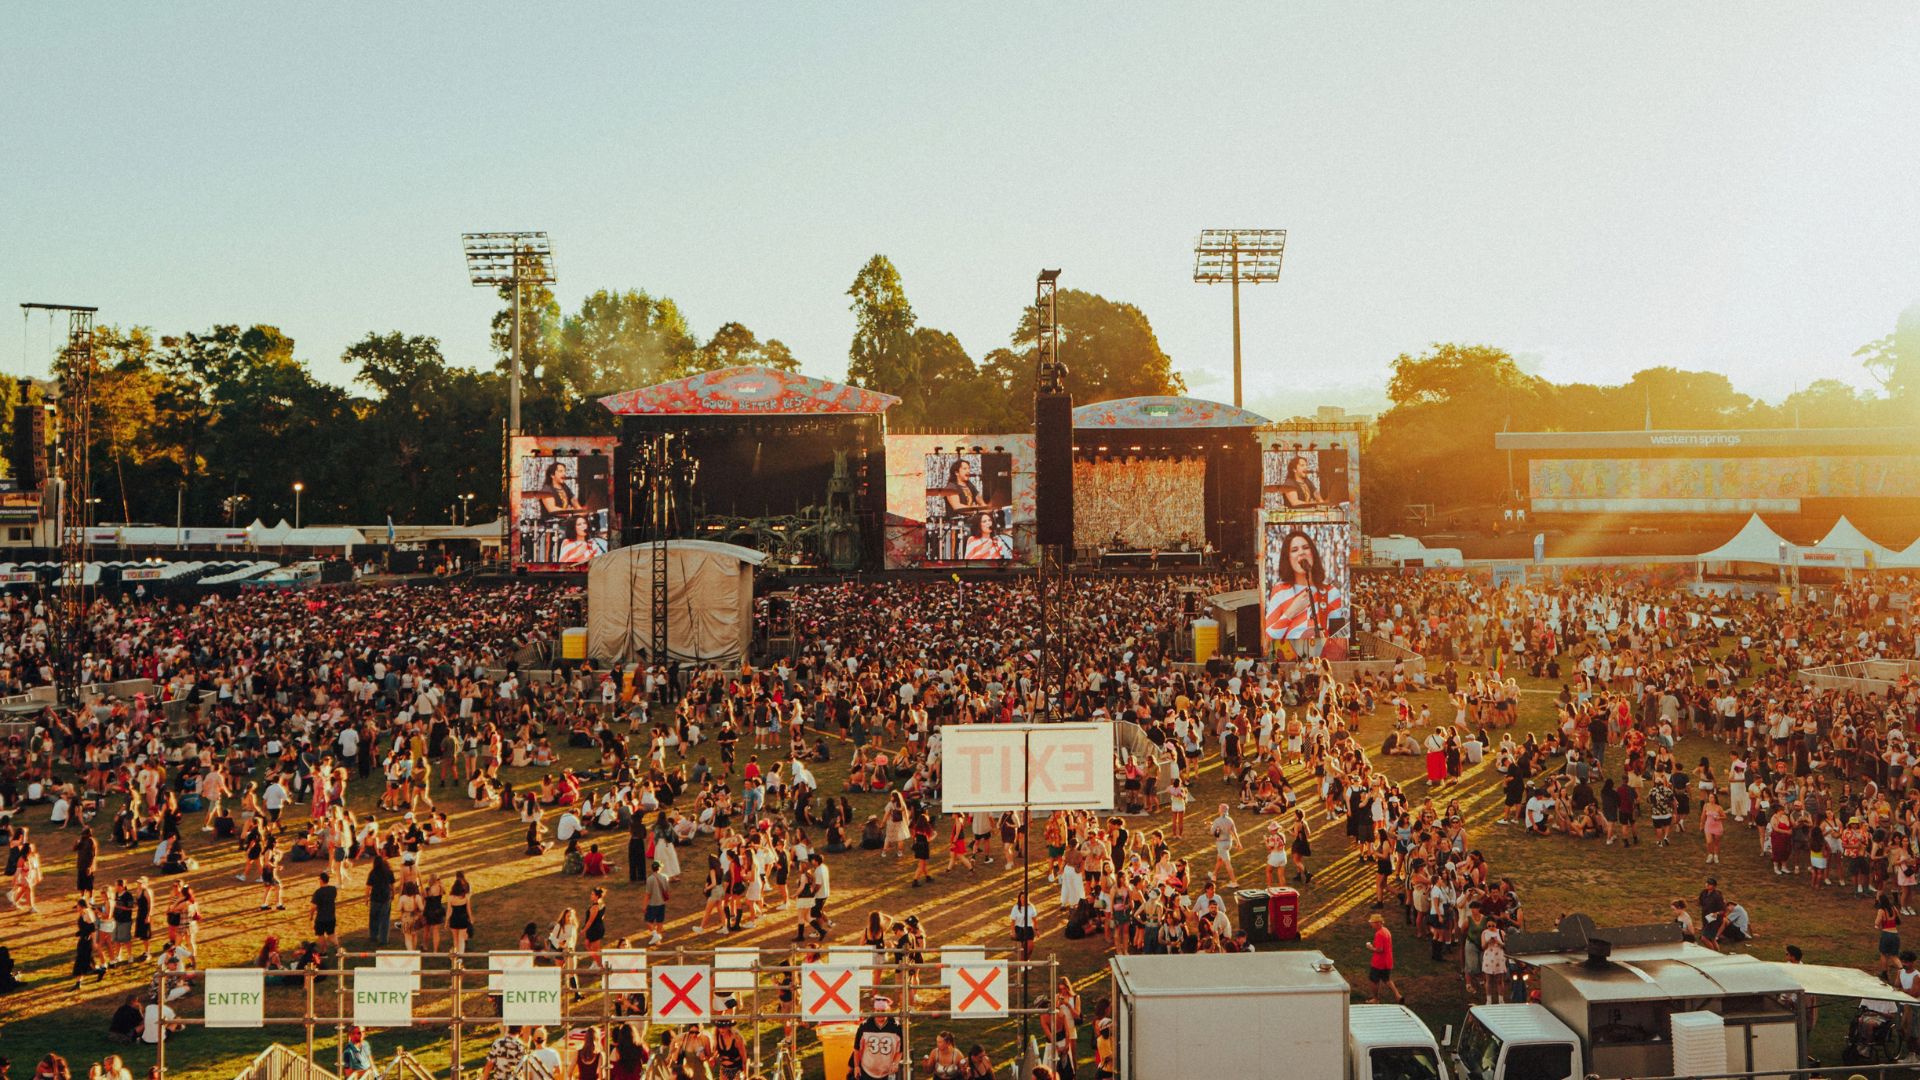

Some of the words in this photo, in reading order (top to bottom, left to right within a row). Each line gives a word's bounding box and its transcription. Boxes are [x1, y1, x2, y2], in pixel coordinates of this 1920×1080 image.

[702, 397, 732, 409] GOOD
[739, 400, 777, 410] BETTER
[783, 397, 808, 409] BEST
[1650, 434, 1698, 445] western
[1699, 433, 1741, 447] springs
[208, 992, 260, 1005] ENTRY
[357, 991, 408, 1004] ENTRY
[506, 991, 558, 1003] ENTRY
[867, 1036, 893, 1055] 33
